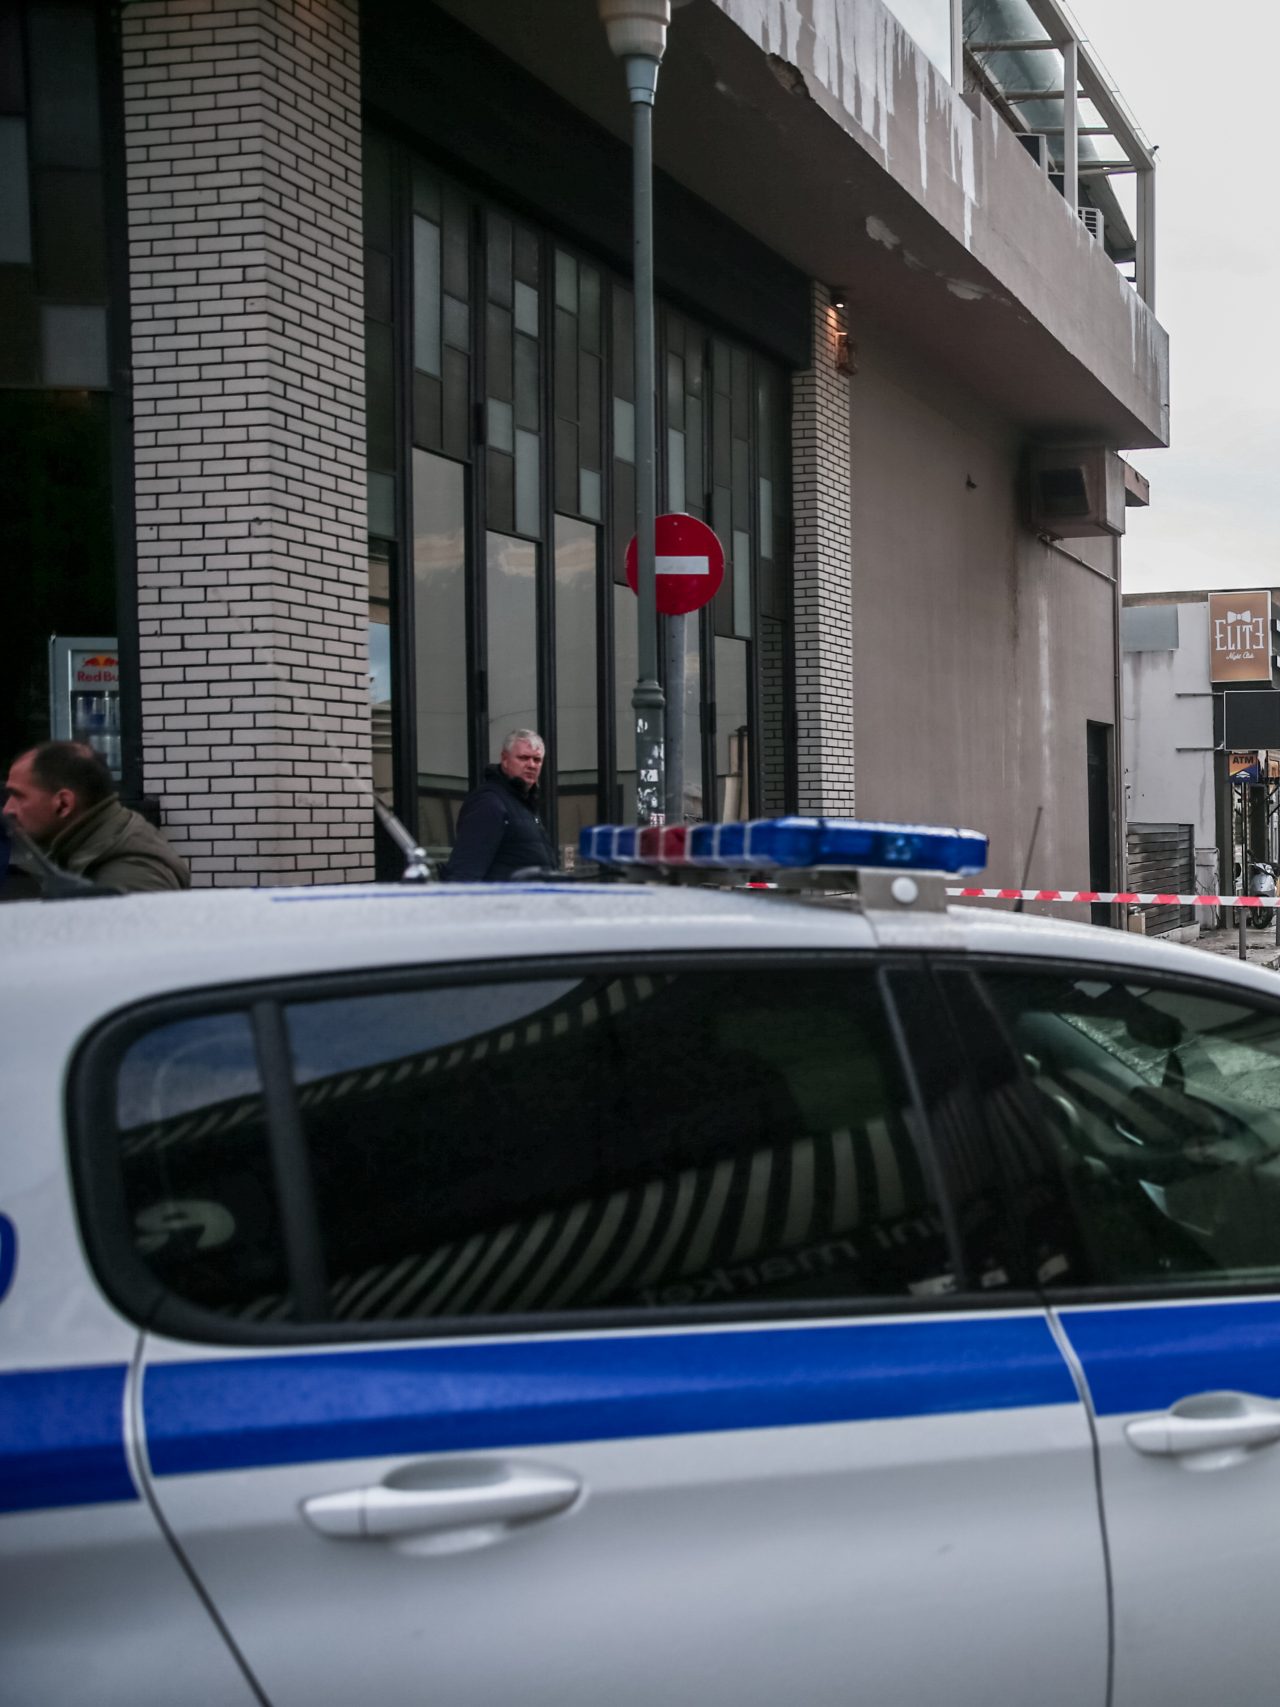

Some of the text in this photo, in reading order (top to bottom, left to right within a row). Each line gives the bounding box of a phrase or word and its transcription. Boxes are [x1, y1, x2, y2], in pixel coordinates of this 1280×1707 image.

[1215, 617, 1264, 651] ELITE
[77, 671, 119, 682] Red Bu
[1233, 756, 1254, 765] ATM
